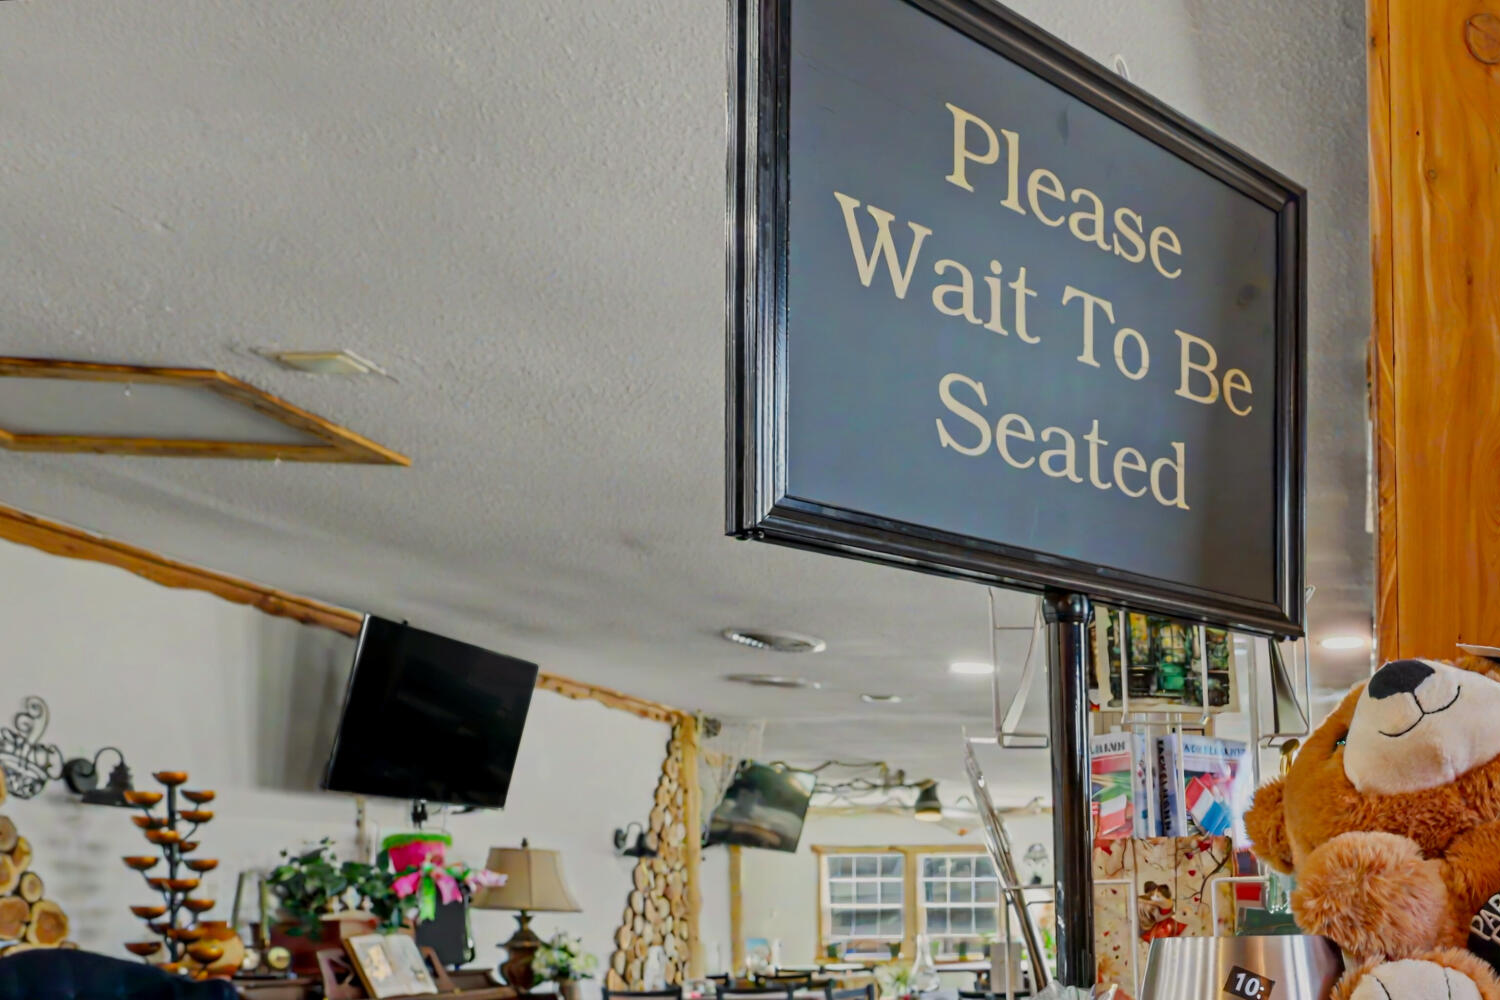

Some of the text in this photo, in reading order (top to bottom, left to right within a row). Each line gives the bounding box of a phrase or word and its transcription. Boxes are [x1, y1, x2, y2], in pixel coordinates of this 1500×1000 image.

[944, 102, 1182, 279] Please
[834, 191, 1253, 417] Wait To Be
[935, 372, 1190, 511] Seated
[1235, 973, 1265, 1000] 10:
